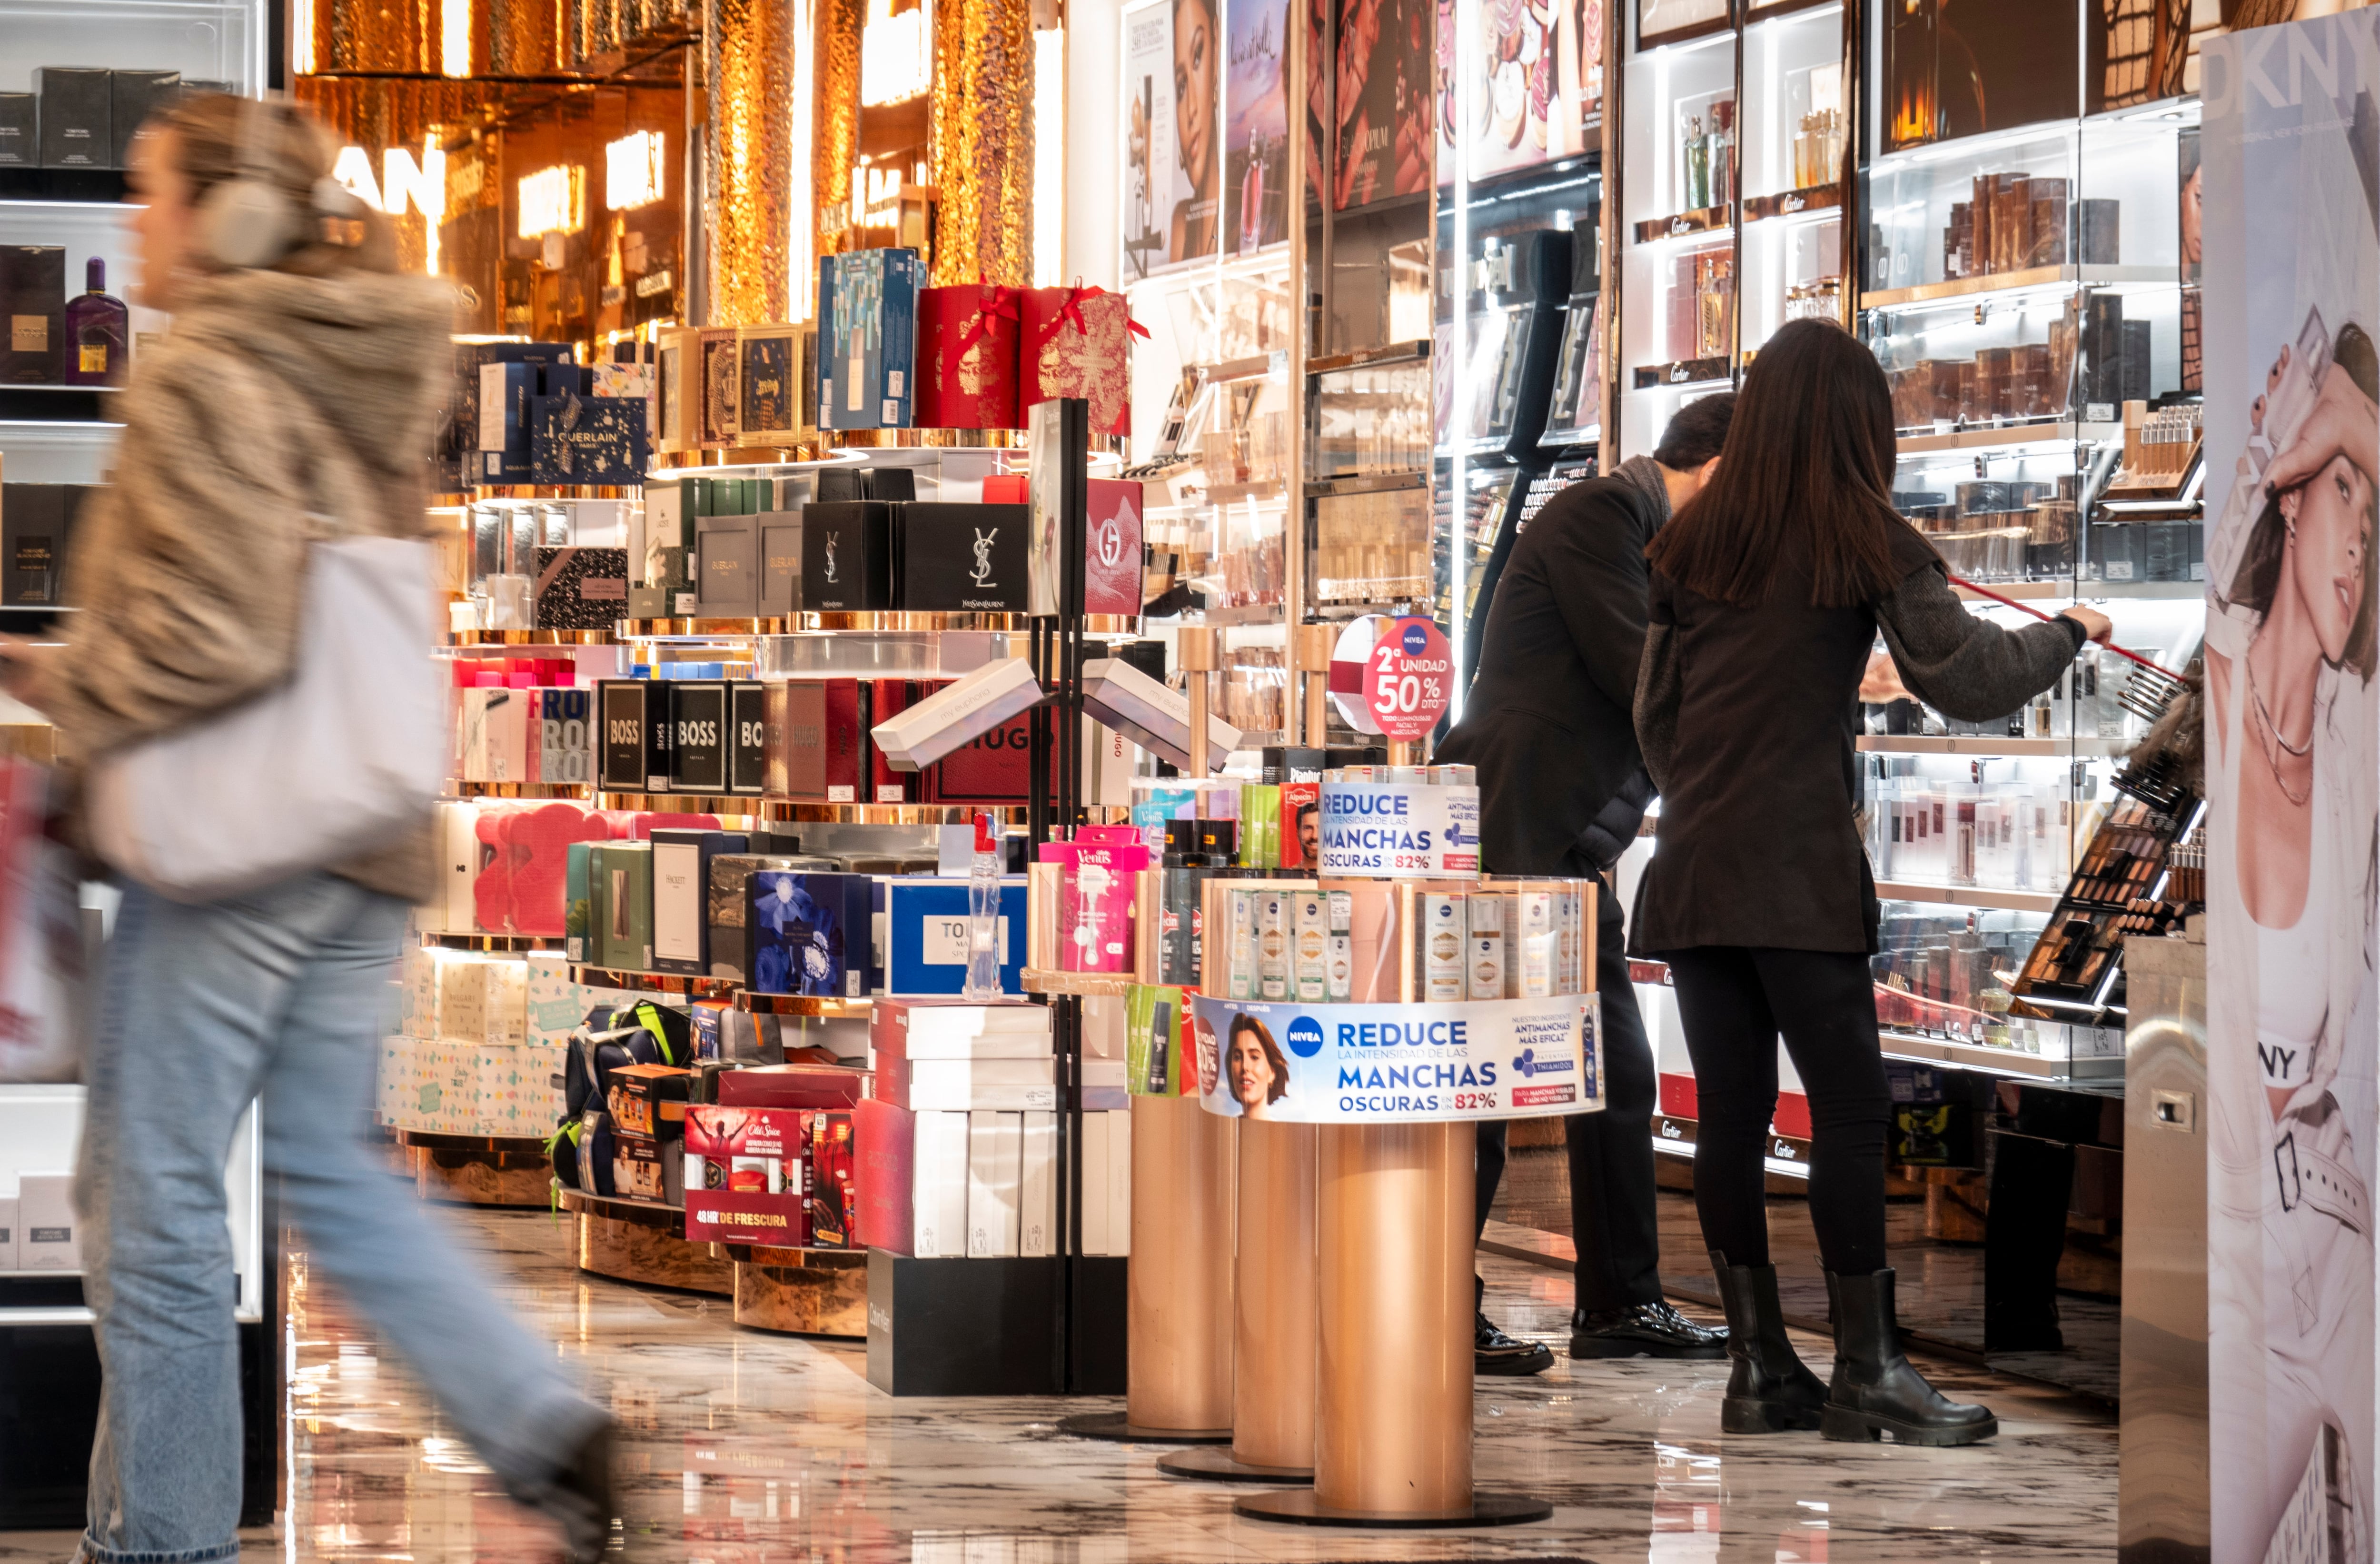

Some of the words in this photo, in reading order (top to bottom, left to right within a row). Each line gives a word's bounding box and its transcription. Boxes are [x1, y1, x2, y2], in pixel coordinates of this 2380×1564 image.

[2200, 6, 2379, 120] DKNY
[1785, 194, 1805, 211] Cartier
[1672, 218, 1691, 235] Cartier
[1670, 365, 1690, 382] Cartier
[770, 557, 797, 568] GUERLAIN
[1376, 646, 1401, 672] 2ª
[1400, 659, 1448, 672] UNIDAD
[940, 707, 953, 720] my
[955, 688, 990, 713] euphoria
[1150, 689, 1161, 701] my
[1163, 699, 1189, 717] eupho
[543, 719, 590, 750] RO
[610, 720, 639, 745] BOSS
[657, 723, 665, 750] BOSS
[678, 721, 717, 747] BOSS
[742, 722, 762, 747] BO
[542, 751, 590, 781] RO
[1289, 794, 1311, 802] Alpecin
[1323, 794, 1408, 815] REDUCE
[1141, 810, 1163, 822] Venus
[1329, 816, 1372, 825] INTENSIDAD
[1375, 817, 1387, 825] DE
[1390, 817, 1408, 825] LAS
[1323, 829, 1431, 850] MANCHAS
[1077, 850, 1111, 863] Venus
[1322, 854, 1381, 868] OSCURAS
[1512, 1016, 1540, 1024] NUESTRO
[1515, 1022, 1570, 1034] ANTIMANCHAS
[1290, 1032, 1321, 1043] NIVEA
[1337, 1021, 1468, 1047] REDUCE
[1519, 1032, 1537, 1045] MÁS
[1338, 1049, 1352, 1060] LA
[1355, 1048, 1425, 1059] INTENSIDAD
[1428, 1048, 1444, 1058] DE
[1447, 1047, 1468, 1057] LAS
[1337, 1062, 1497, 1089] MANCHAS
[1555, 1086, 1574, 1094] VISIBLES
[1339, 1095, 1439, 1111] OSCURAS
[747, 1125, 762, 1136] Old
[762, 1125, 781, 1137] Spice
[1662, 1121, 1681, 1138] Cartier
[1775, 1140, 1795, 1158] Cartier
[720, 1212, 733, 1225] DE
[734, 1213, 787, 1227] FRESCURA
